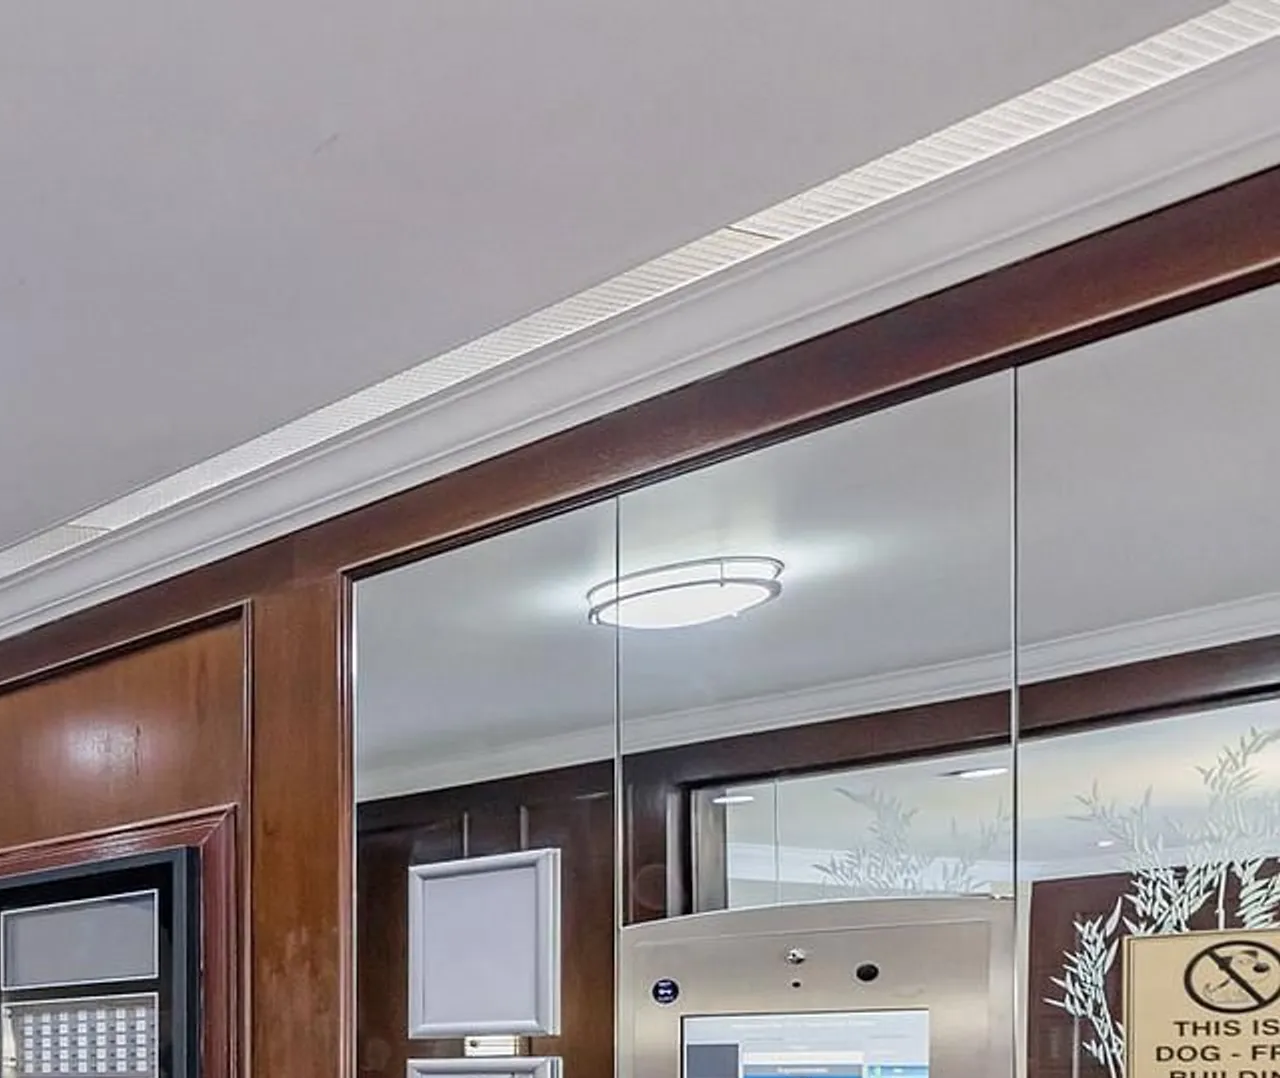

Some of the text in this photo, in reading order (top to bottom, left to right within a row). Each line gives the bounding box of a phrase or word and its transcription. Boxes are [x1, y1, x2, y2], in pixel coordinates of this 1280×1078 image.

[1173, 1018, 1279, 1037] THIS IS
[1155, 1045, 1221, 1062] DOG
